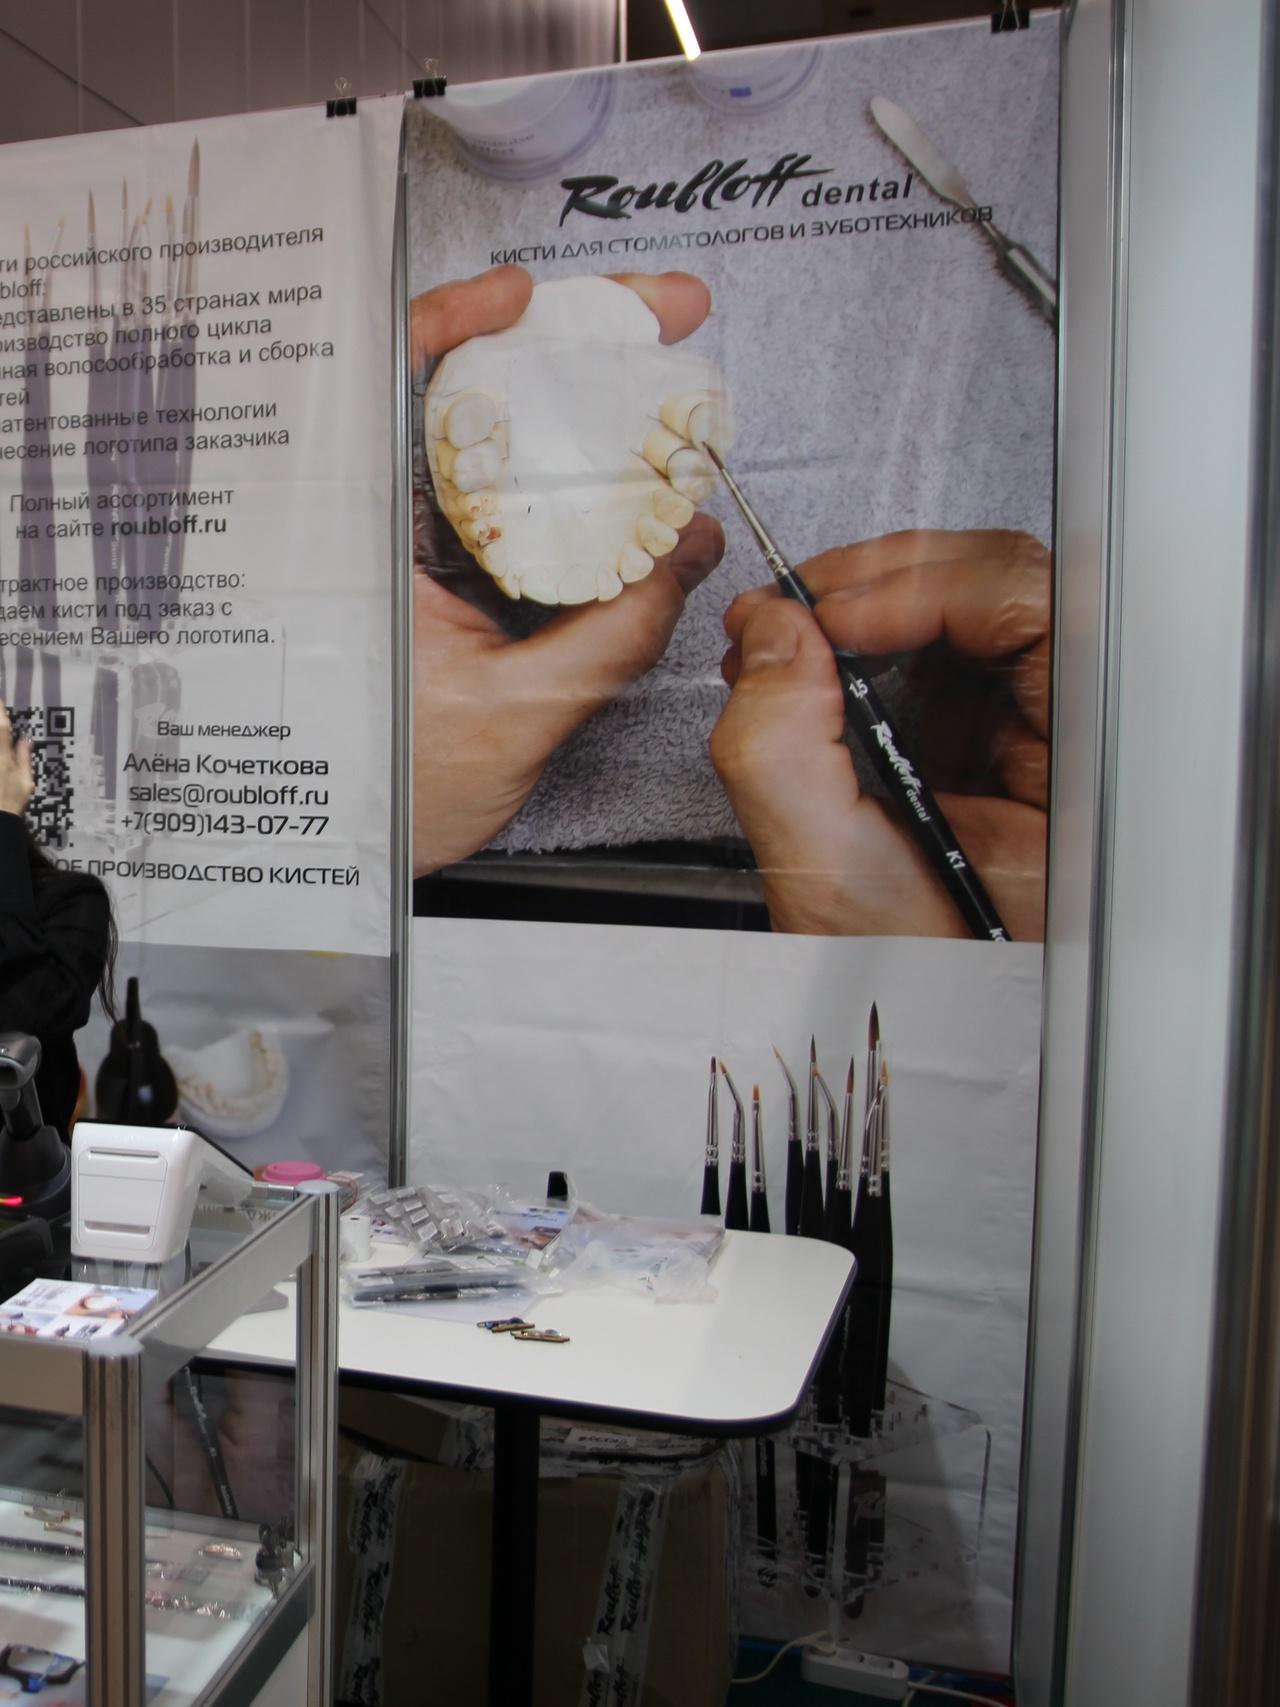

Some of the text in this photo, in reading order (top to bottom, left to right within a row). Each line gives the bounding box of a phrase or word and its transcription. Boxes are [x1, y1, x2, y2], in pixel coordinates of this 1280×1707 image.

[560, 153, 913, 227] Roubloff dental
[490, 206, 993, 266] КИСТИ ДЛЯ СТОМАТОЛОГОВ И ЗУБОТЕХНИКОВ
[25, 243, 152, 275] российского
[159, 226, 324, 261] производителя
[122, 302, 134, 317] в
[141, 296, 167, 316] 35
[174, 291, 261, 317] странах
[267, 284, 323, 306] мира
[115, 324, 200, 345] полного
[207, 316, 272, 341] цикла
[44, 349, 231, 378] волосообработка
[238, 349, 252, 364] и
[258, 339, 334, 361] сборка
[156, 402, 277, 425] технологии
[83, 434, 179, 456] логотипа
[185, 429, 290, 451] заказчика
[10, 490, 90, 513] Полный
[96, 488, 234, 511] ассортимент
[16, 515, 227, 539] на сайте roubloff.ru
[95, 573, 245, 595] производство:
[52, 603, 107, 619] кисти
[114, 602, 151, 620] под
[158, 601, 214, 618] заказ
[221, 602, 233, 617] с
[91, 627, 169, 646] Вашего
[176, 627, 275, 645] логотипа.
[157, 721, 291, 740] Ваш менеджер
[123, 753, 329, 776] Алёна Кочеткова
[129, 783, 329, 807] sales@roubloff.ru
[906, 789, 931, 821] dental
[121, 812, 329, 837] +7(909)143-07-77
[87, 860, 263, 884] ПРОИЗВОДСТВО
[269, 865, 360, 887] КИСТЕЙ
